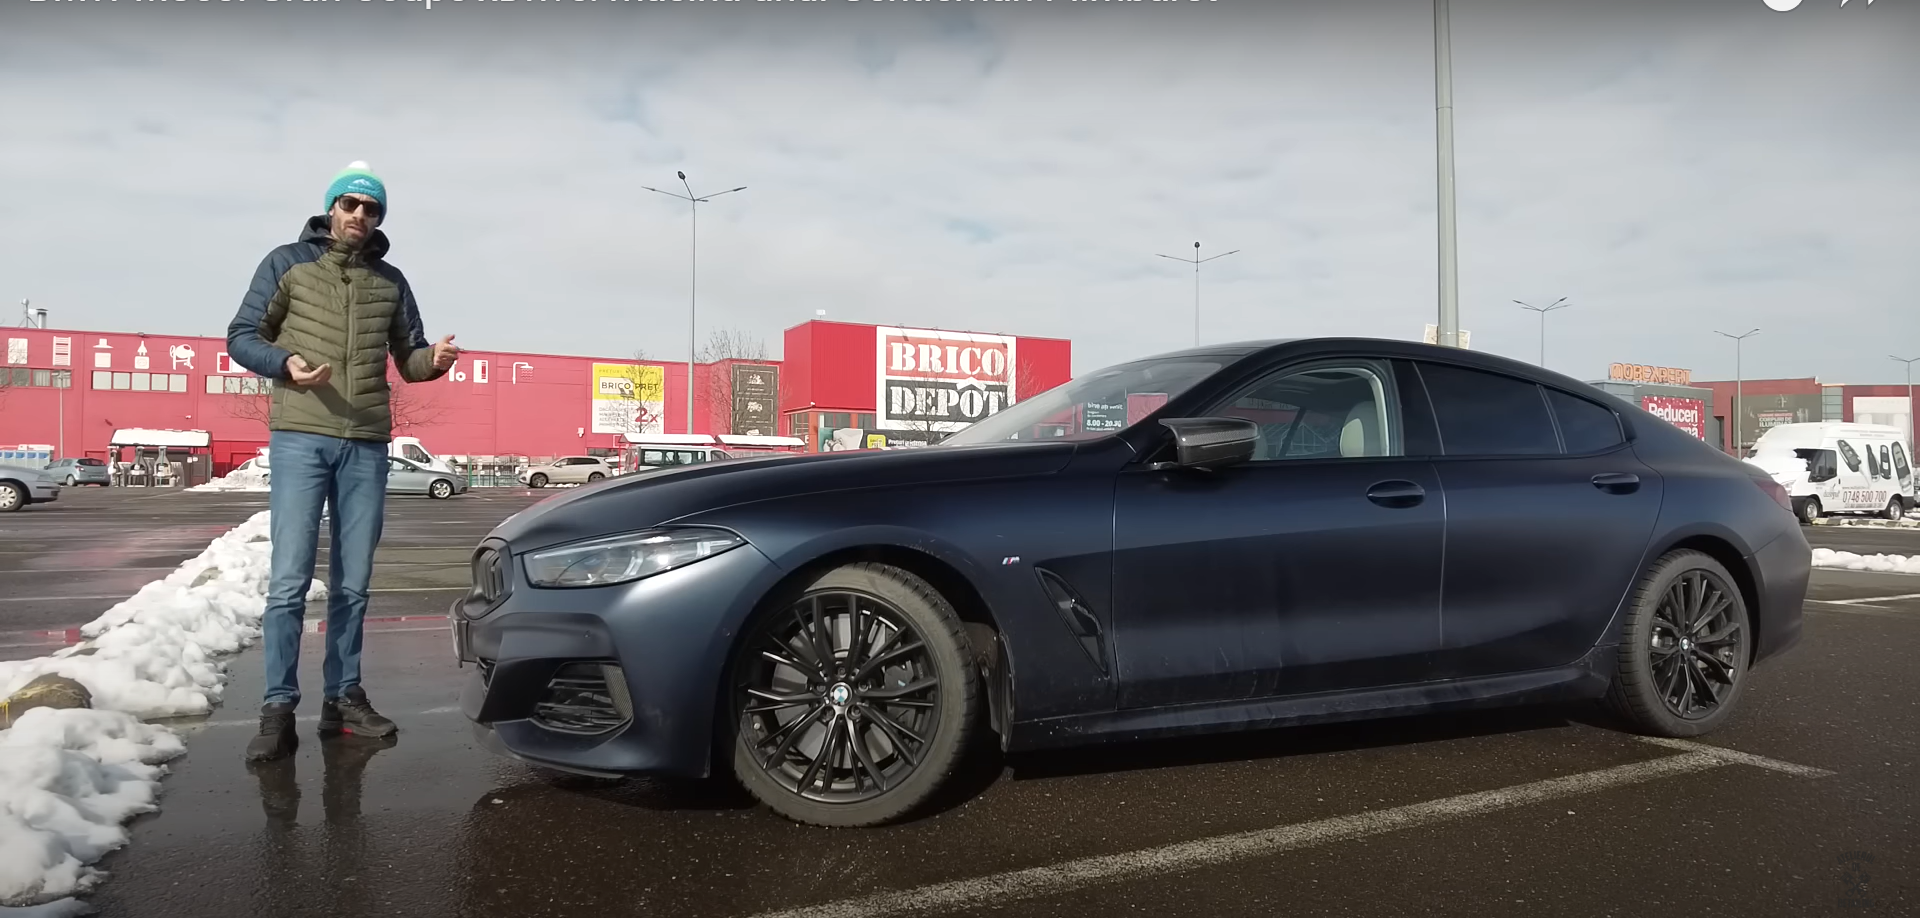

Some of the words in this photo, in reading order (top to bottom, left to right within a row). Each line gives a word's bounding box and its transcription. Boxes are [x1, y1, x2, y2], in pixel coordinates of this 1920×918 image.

[890, 342, 1005, 376] BRICO
[1609, 362, 1691, 384] MOBEXPERT
[601, 381, 631, 390] BRICO
[1648, 403, 1698, 423] Reduceri
[1843, 490, 1860, 503] 0748
[1861, 491, 1874, 503] 500
[1874, 491, 1887, 503] 700
